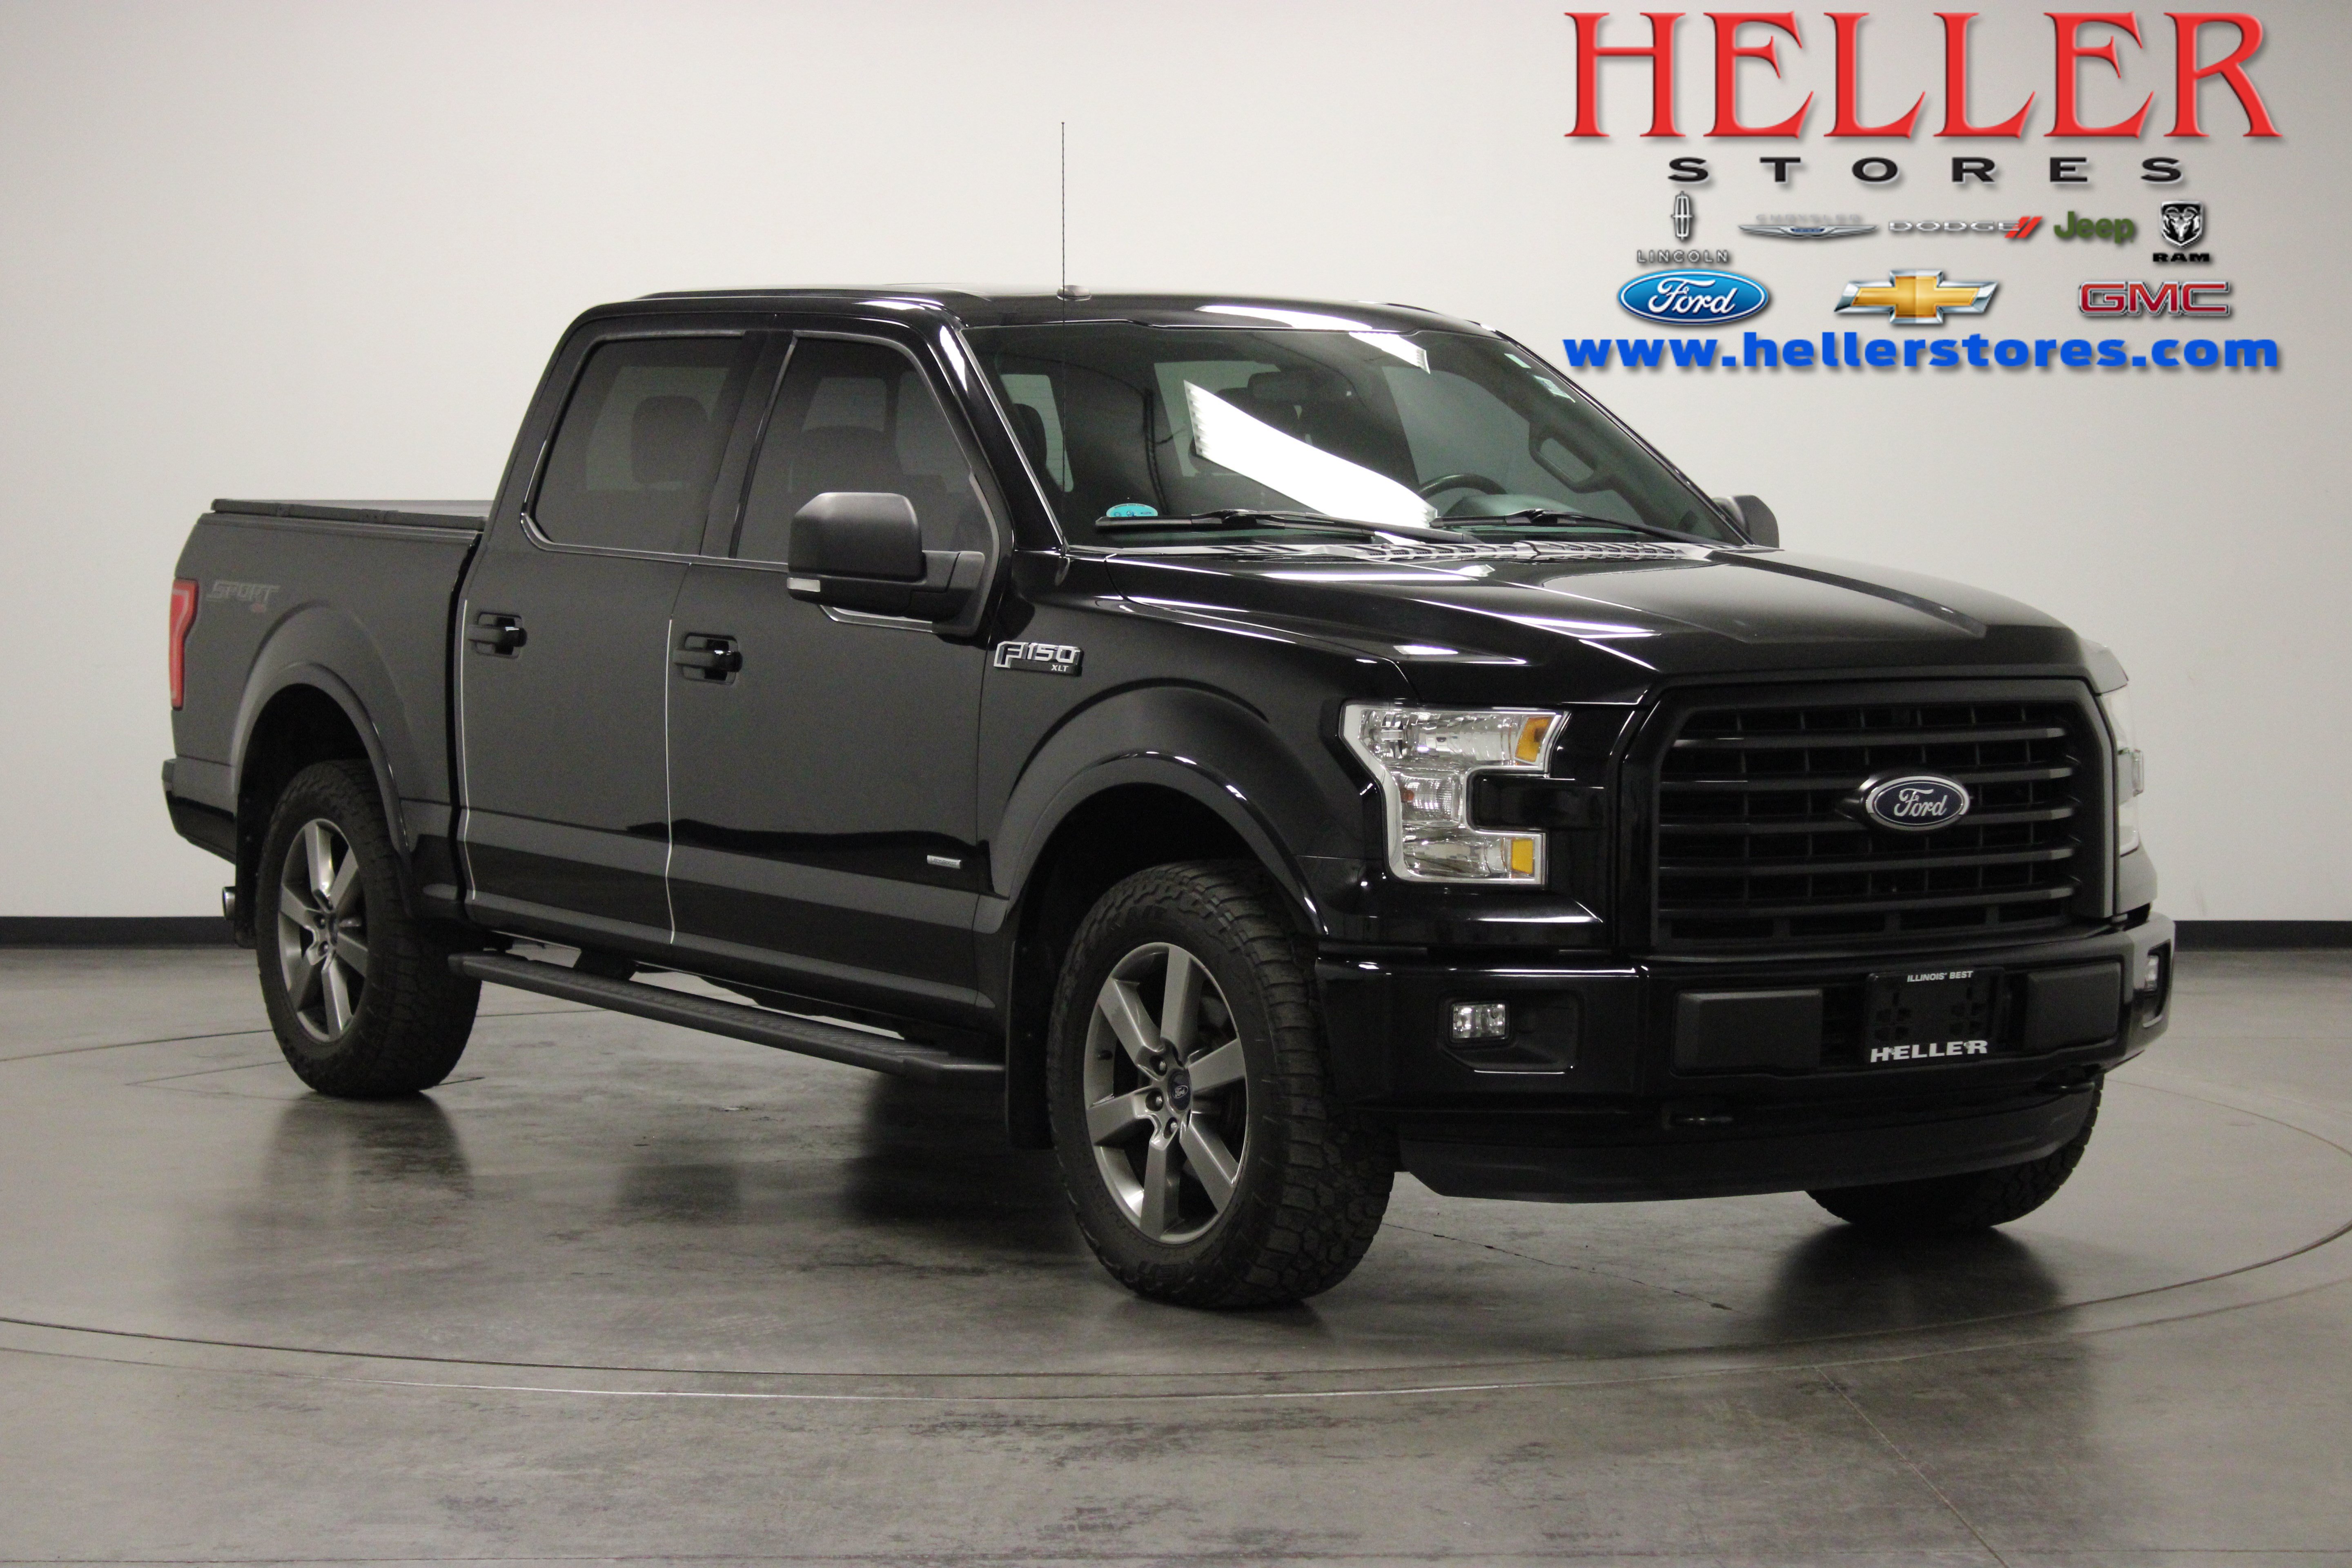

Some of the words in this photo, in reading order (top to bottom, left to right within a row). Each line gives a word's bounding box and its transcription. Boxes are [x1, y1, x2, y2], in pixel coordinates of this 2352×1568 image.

[206, 579, 281, 603] SPORT
[1051, 664, 1069, 672] XLT
[1894, 788, 1947, 817] Ford
[1949, 971, 1973, 979] BEST
[1870, 1040, 1988, 1062] HELLER
